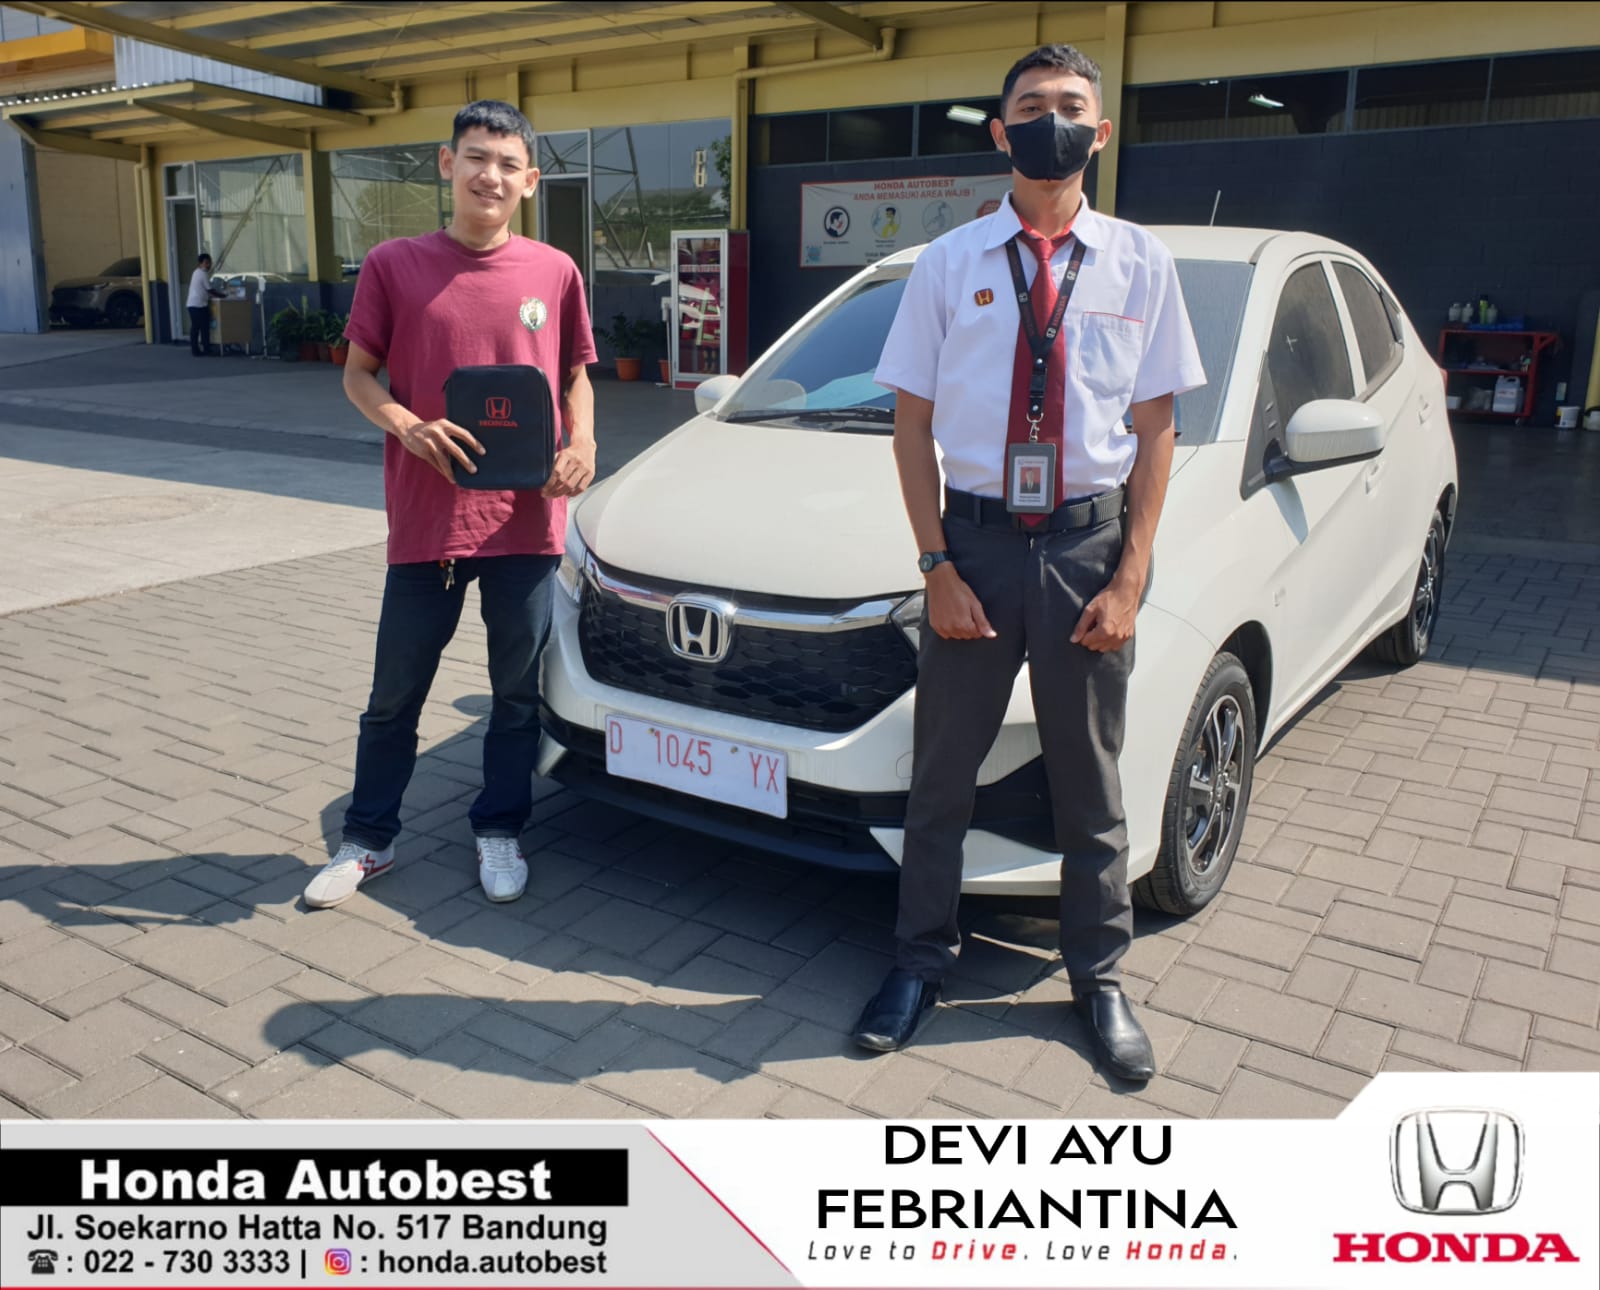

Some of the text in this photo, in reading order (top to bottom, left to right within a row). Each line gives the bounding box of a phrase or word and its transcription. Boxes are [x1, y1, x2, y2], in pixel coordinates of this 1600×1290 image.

[873, 179, 955, 191] HONDA AUTOBEST
[854, 192, 875, 201] ANDA
[876, 190, 919, 200] MEMASUKI
[920, 189, 943, 199] AREA
[944, 188, 970, 198] WAJIB
[479, 419, 518, 428] HONDA
[609, 721, 780, 794] D 1045 YX
